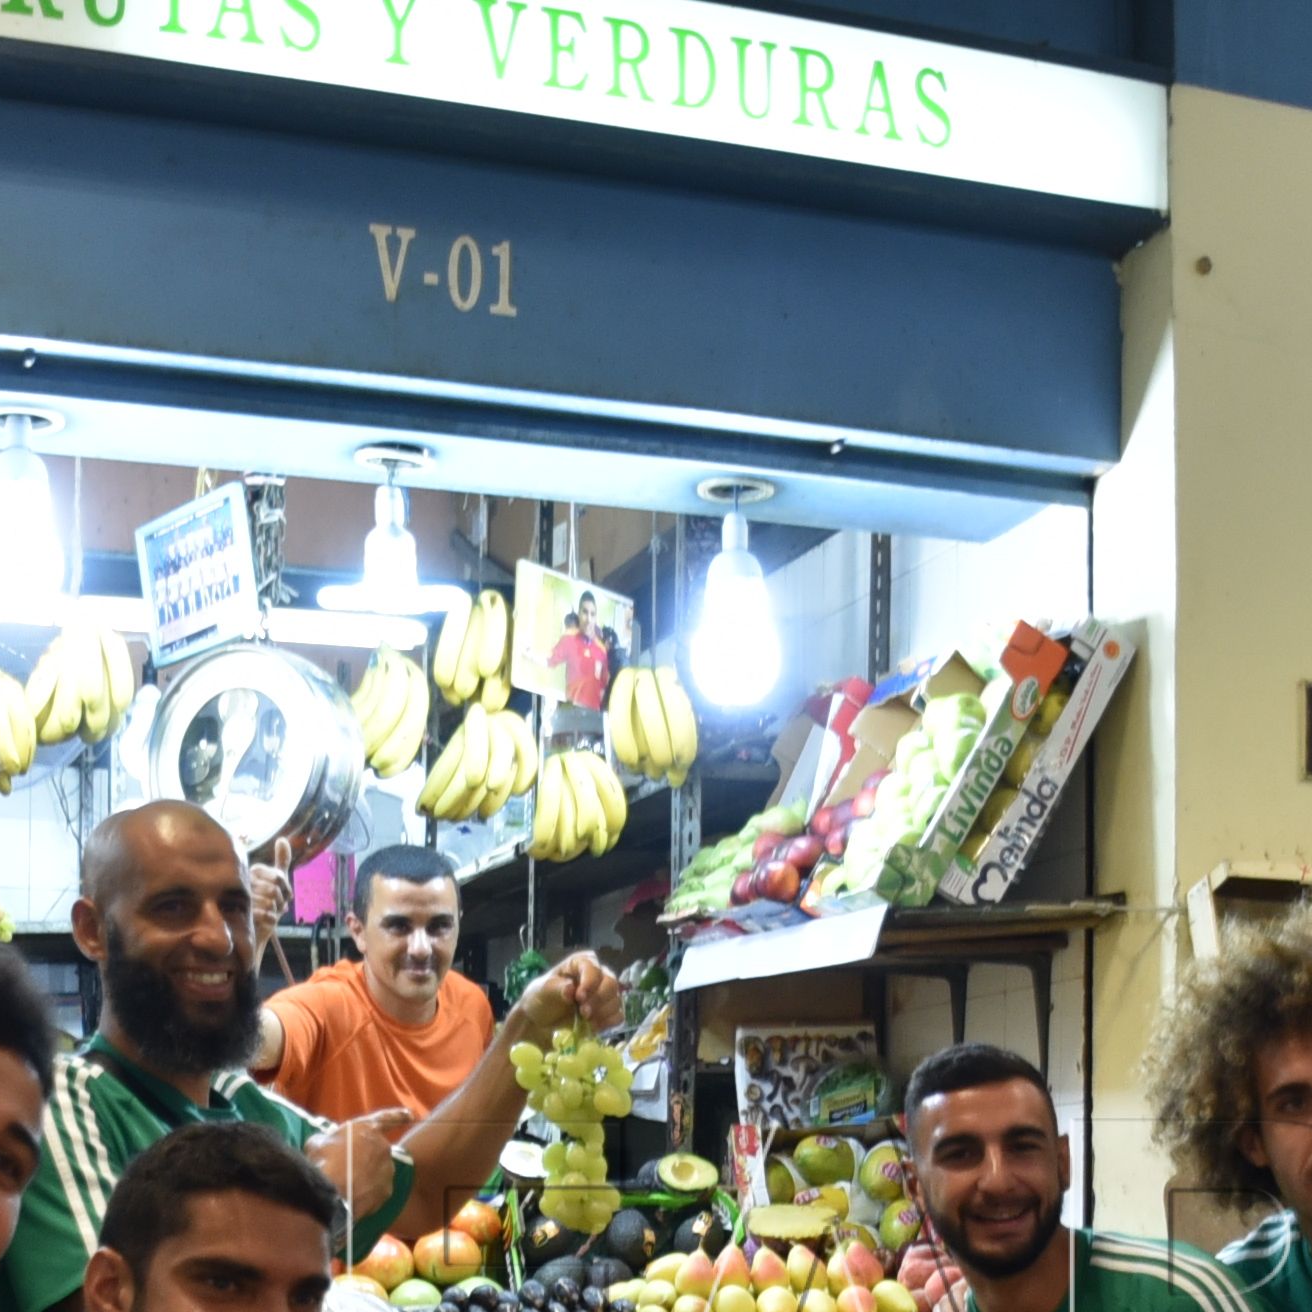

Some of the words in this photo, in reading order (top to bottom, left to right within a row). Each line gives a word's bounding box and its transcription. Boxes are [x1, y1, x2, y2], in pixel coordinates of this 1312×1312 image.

[382, 0, 418, 66] Y
[474, 0, 954, 149] VERDURAS
[369, 223, 519, 318] V-01
